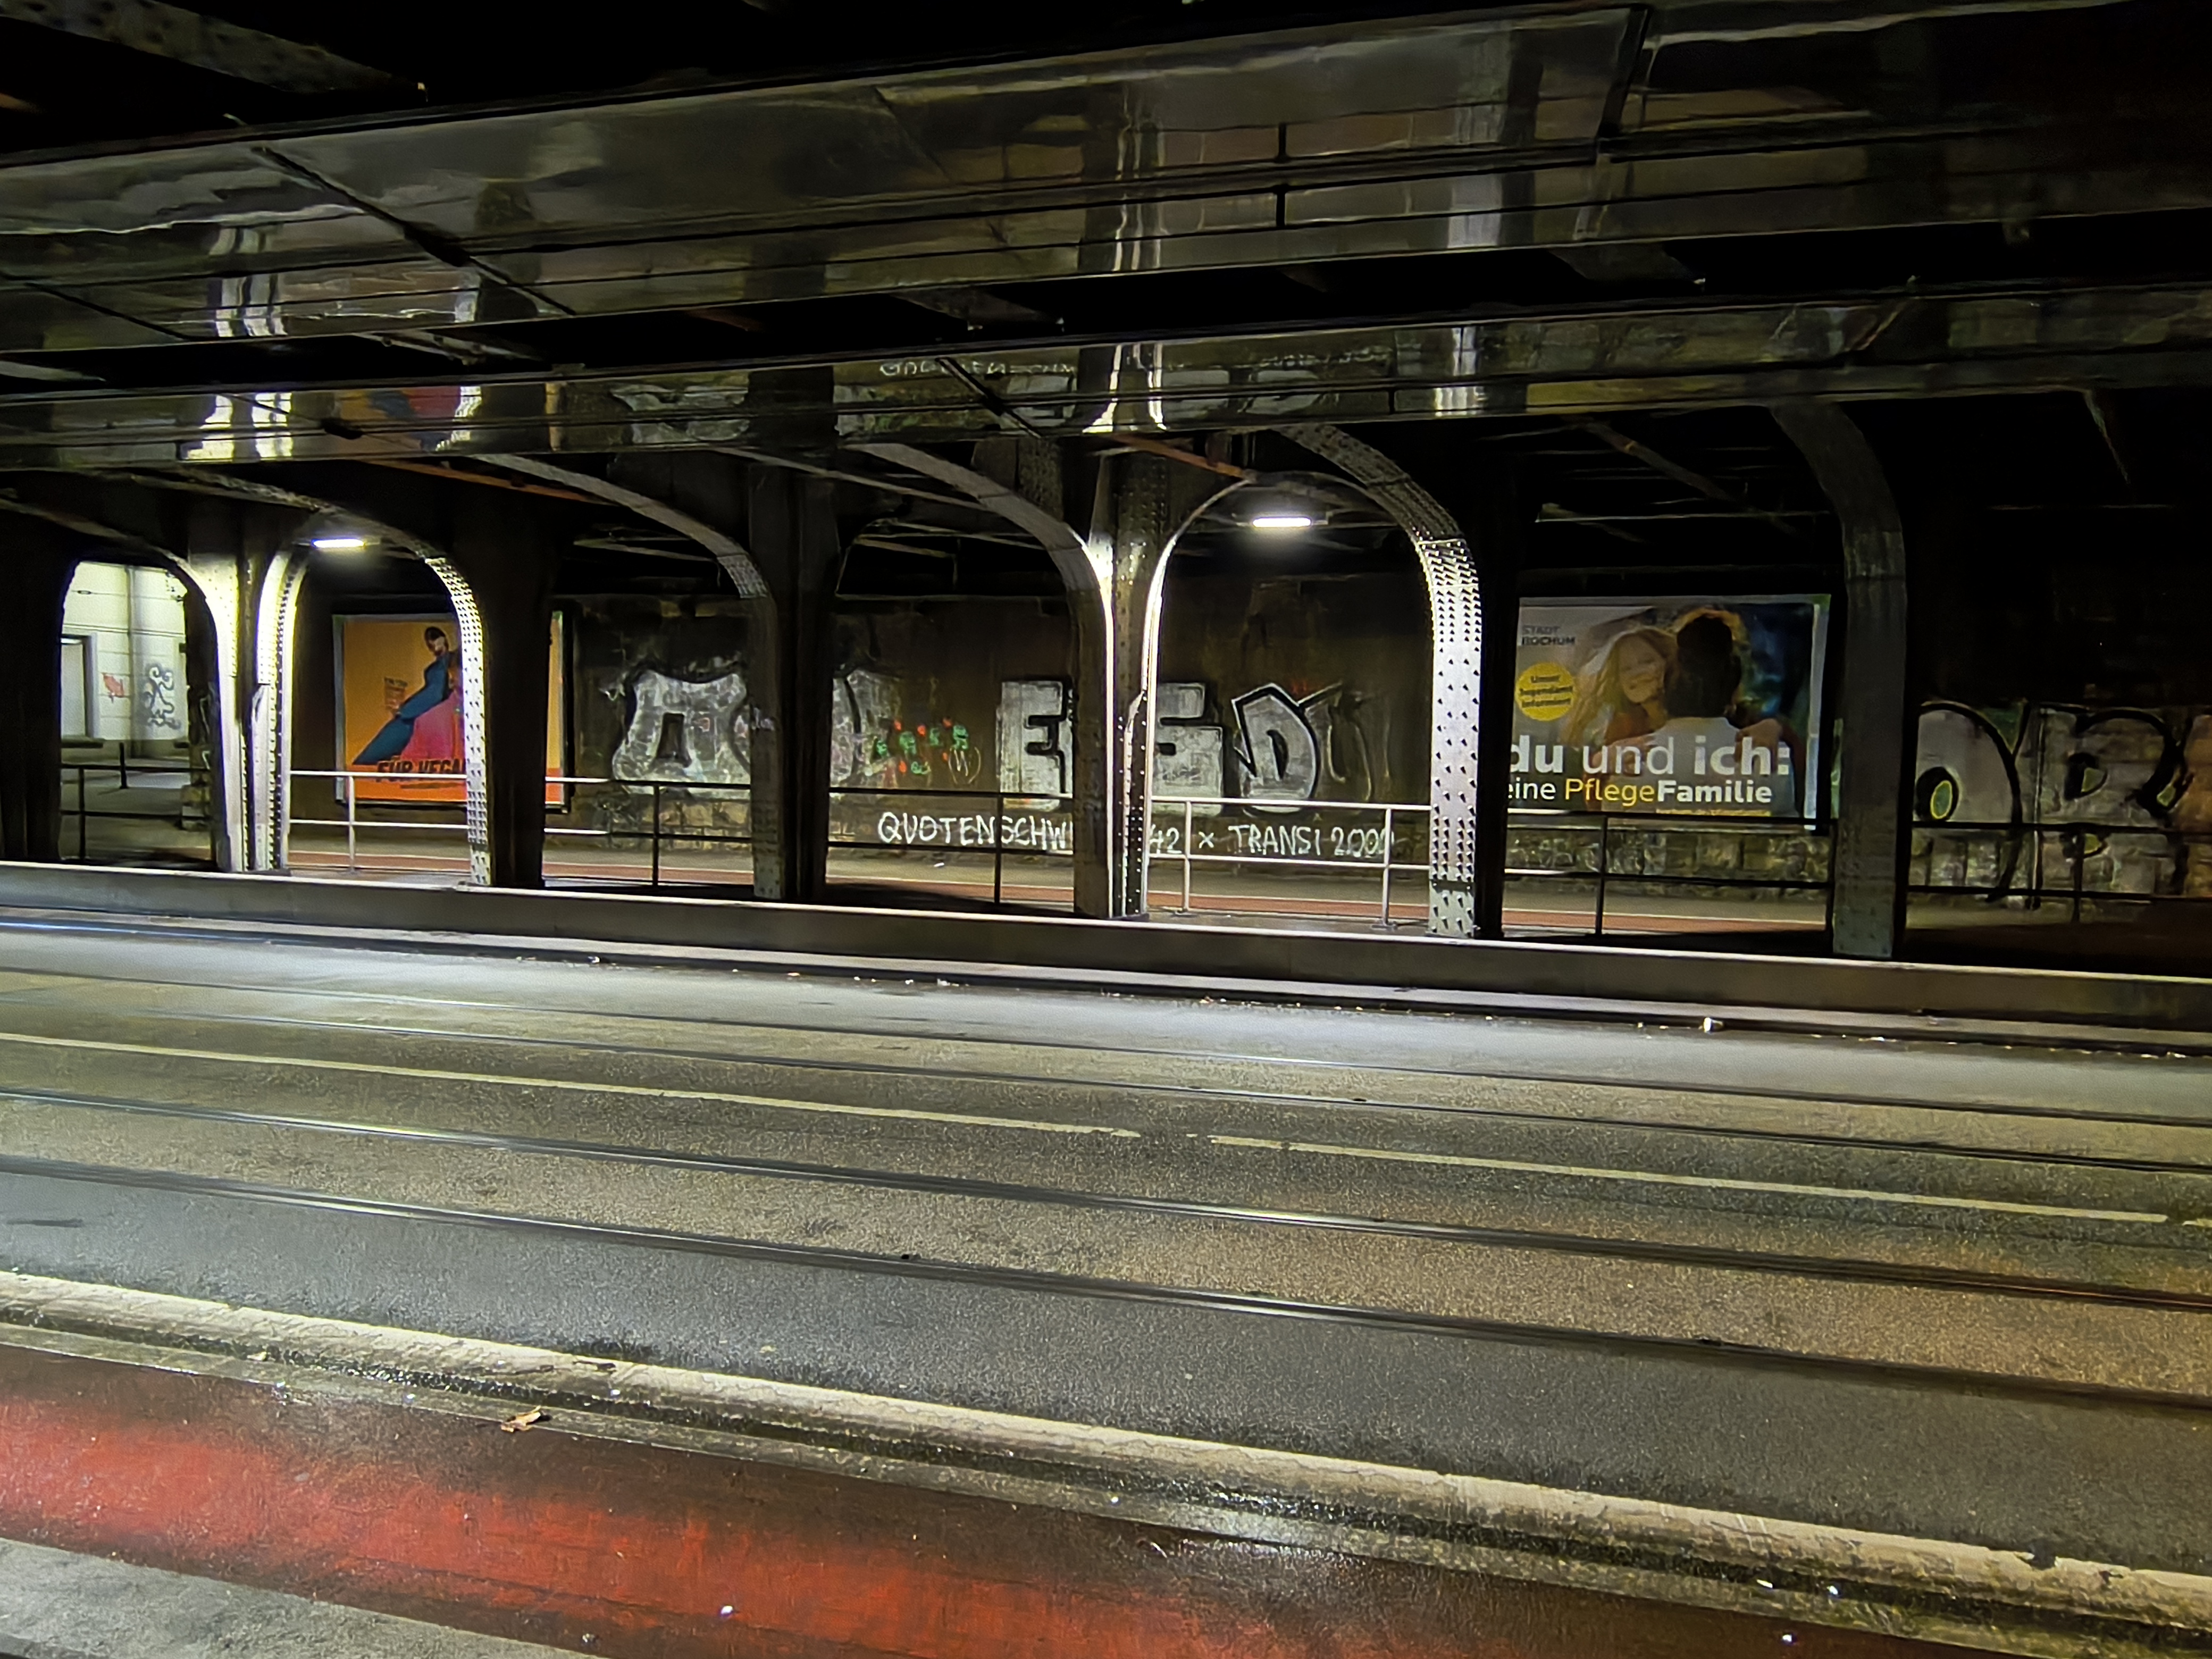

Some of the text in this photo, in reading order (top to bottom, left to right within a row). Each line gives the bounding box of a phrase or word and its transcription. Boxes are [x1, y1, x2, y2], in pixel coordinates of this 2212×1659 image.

[1522, 637, 1576, 646] BOCHUM
[1583, 736, 1674, 775] und
[1694, 735, 1790, 775] ich:
[1565, 778, 1772, 806] PflegeFamilie
